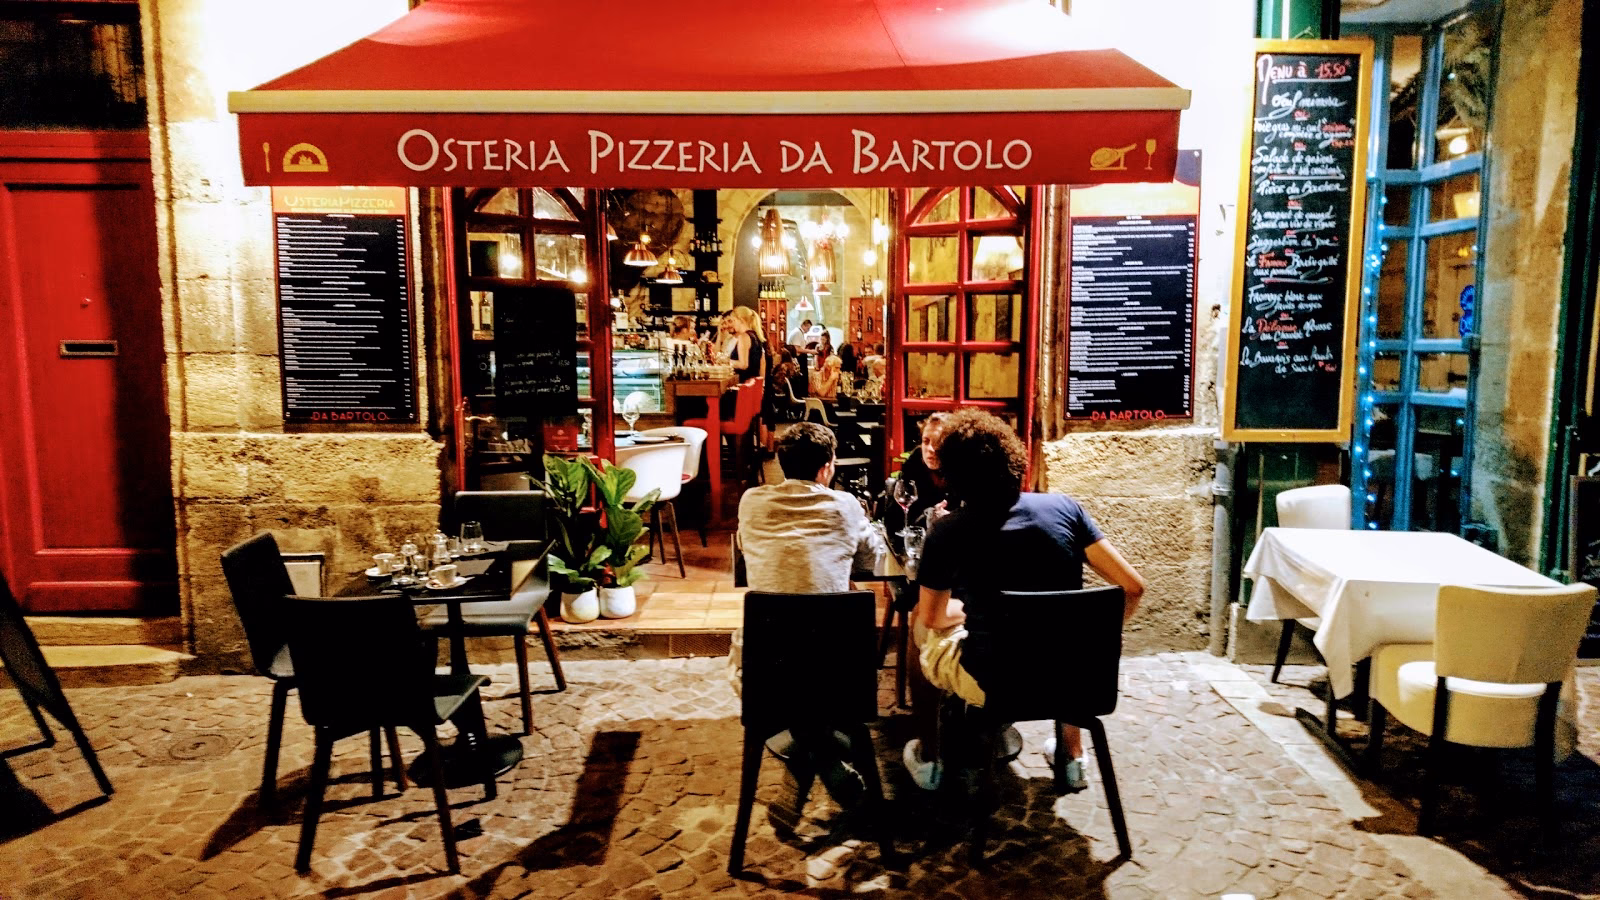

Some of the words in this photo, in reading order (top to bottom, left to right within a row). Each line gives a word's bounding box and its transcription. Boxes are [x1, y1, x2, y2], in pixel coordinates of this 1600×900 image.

[397, 128, 570, 173] OSTERIA
[588, 129, 762, 174] PIZZERIA
[780, 140, 833, 174] DA
[851, 128, 1033, 174] BARTOLO
[312, 411, 328, 421] DA
[331, 411, 388, 421] BARTOLO
[1092, 411, 1107, 421] DA
[1110, 409, 1165, 421] BARTOLO
